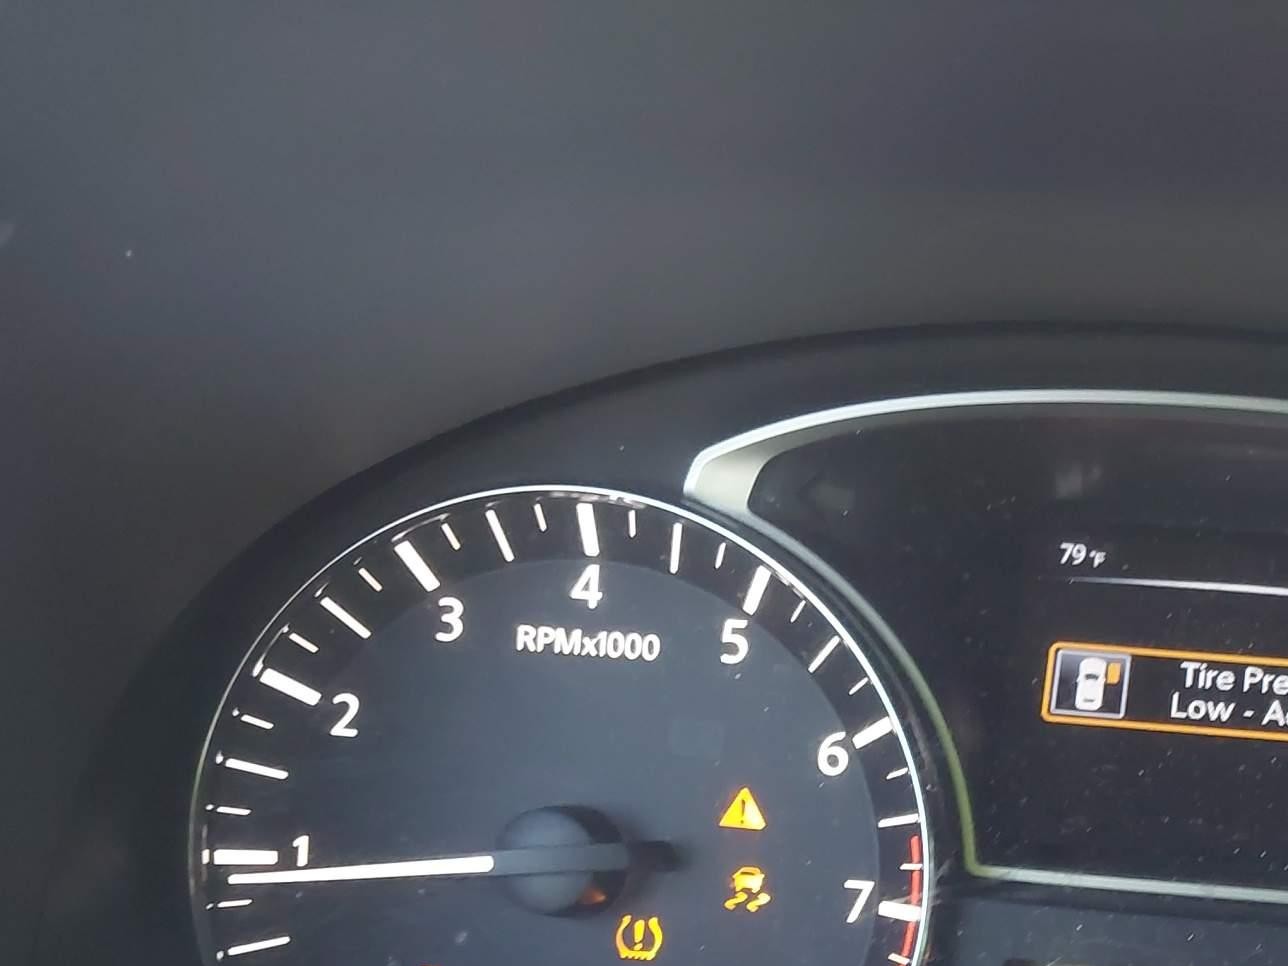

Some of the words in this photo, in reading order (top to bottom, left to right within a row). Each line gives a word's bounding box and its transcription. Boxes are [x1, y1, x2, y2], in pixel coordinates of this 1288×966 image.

[1059, 542, 1086, 565] 79
[569, 563, 603, 609] 4
[435, 597, 464, 642] 3
[720, 618, 749, 664] 5
[516, 624, 661, 662] RPMx1000
[1180, 661, 1235, 690] Tire
[330, 692, 360, 737] 2
[1170, 692, 1235, 721] Low
[817, 731, 849, 777] 6
[292, 834, 310, 867] 1
[843, 879, 875, 923] 7
